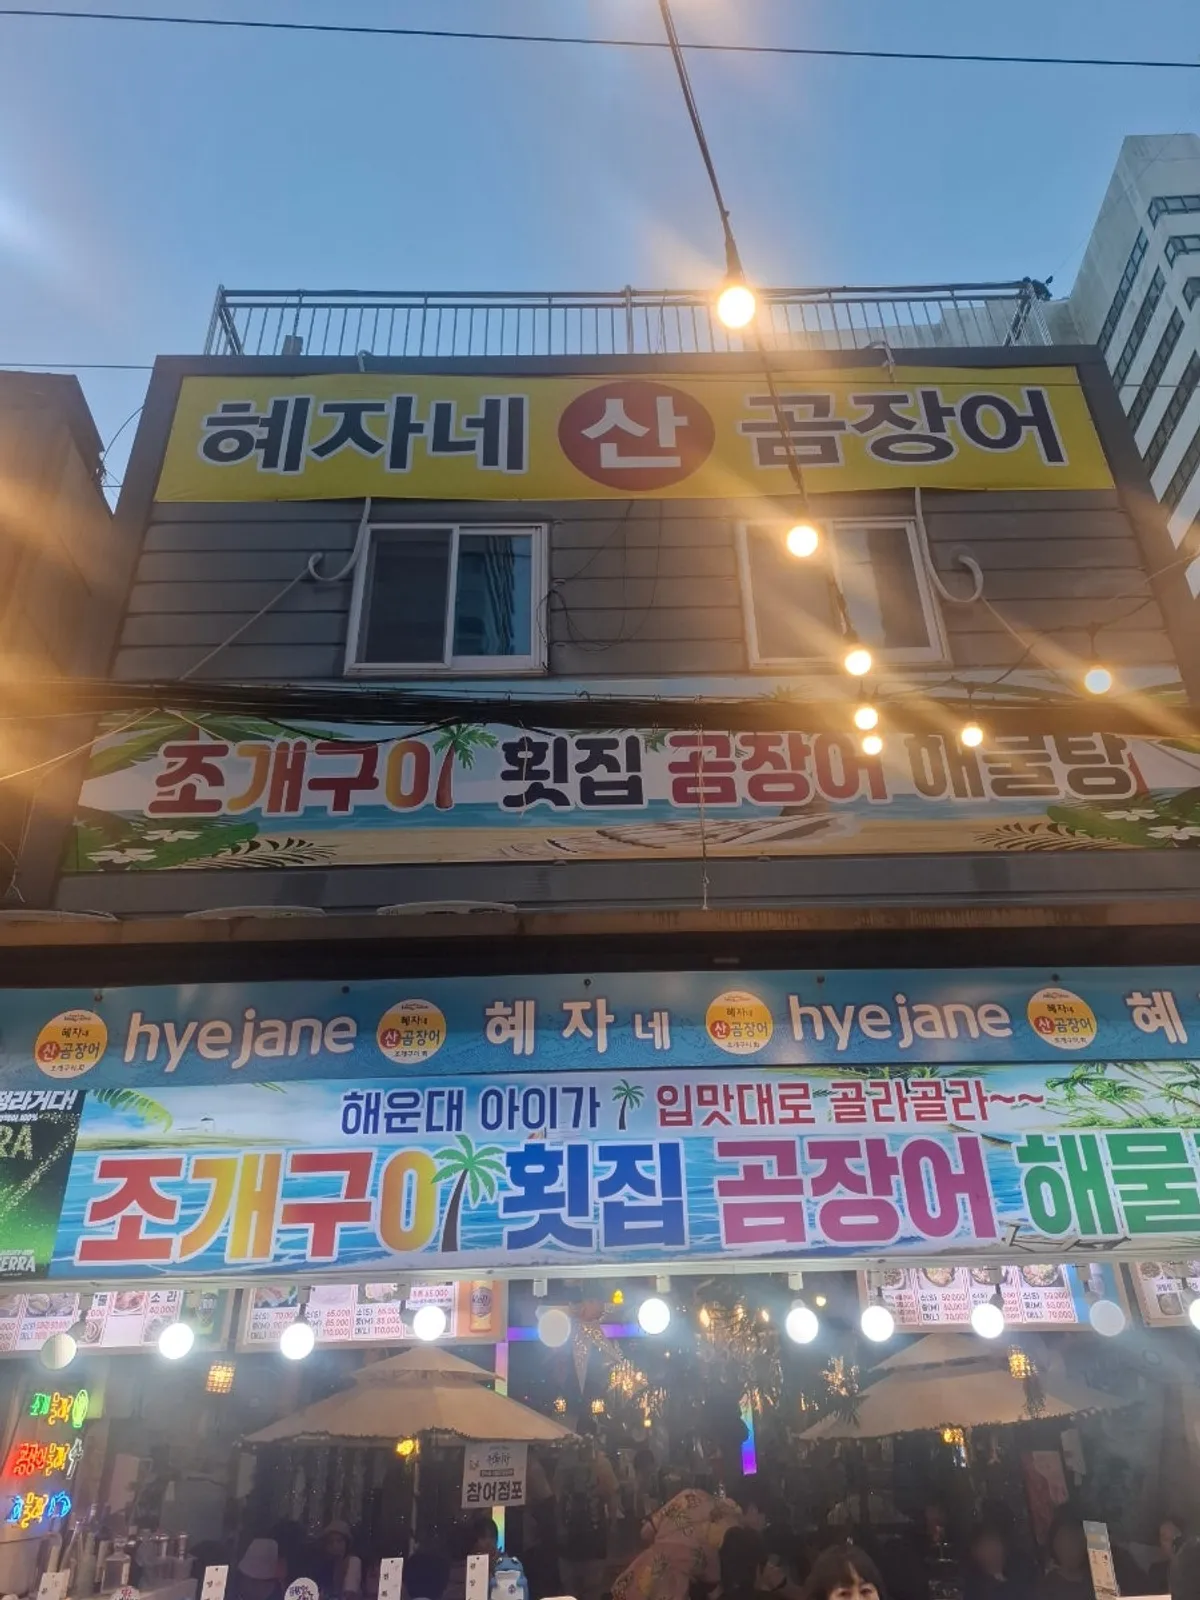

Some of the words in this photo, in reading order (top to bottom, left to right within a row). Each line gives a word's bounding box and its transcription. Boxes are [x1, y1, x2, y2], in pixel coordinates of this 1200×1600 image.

[200, 395, 527, 474] 혜자네
[582, 396, 688, 468] 산
[740, 388, 1068, 466] 곰장어
[147, 740, 458, 815] 조개구이
[500, 735, 645, 808] 횟집
[667, 733, 887, 805] 곰장어
[123, 1008, 357, 1072] hyejane
[401, 1030, 440, 1046] 곰장어
[731, 1021, 768, 1037] 곰장어
[788, 994, 1013, 1050] hyejane
[1055, 1018, 1093, 1033] 곰장어
[60, 1042, 100, 1059] 곰장어
[341, 1088, 464, 1134] 해운대
[480, 1086, 600, 1131] 아이가
[656, 1081, 816, 1127] 입맛대로
[77, 1148, 470, 1262] 조개구이
[502, 1141, 687, 1250] 횟집
[715, 1136, 997, 1246] 곰장어
[1012, 1130, 1200, 1239] 해물
[0, 1256, 36, 1272] ERRA
[466, 1480, 523, 1502] 참여점포
